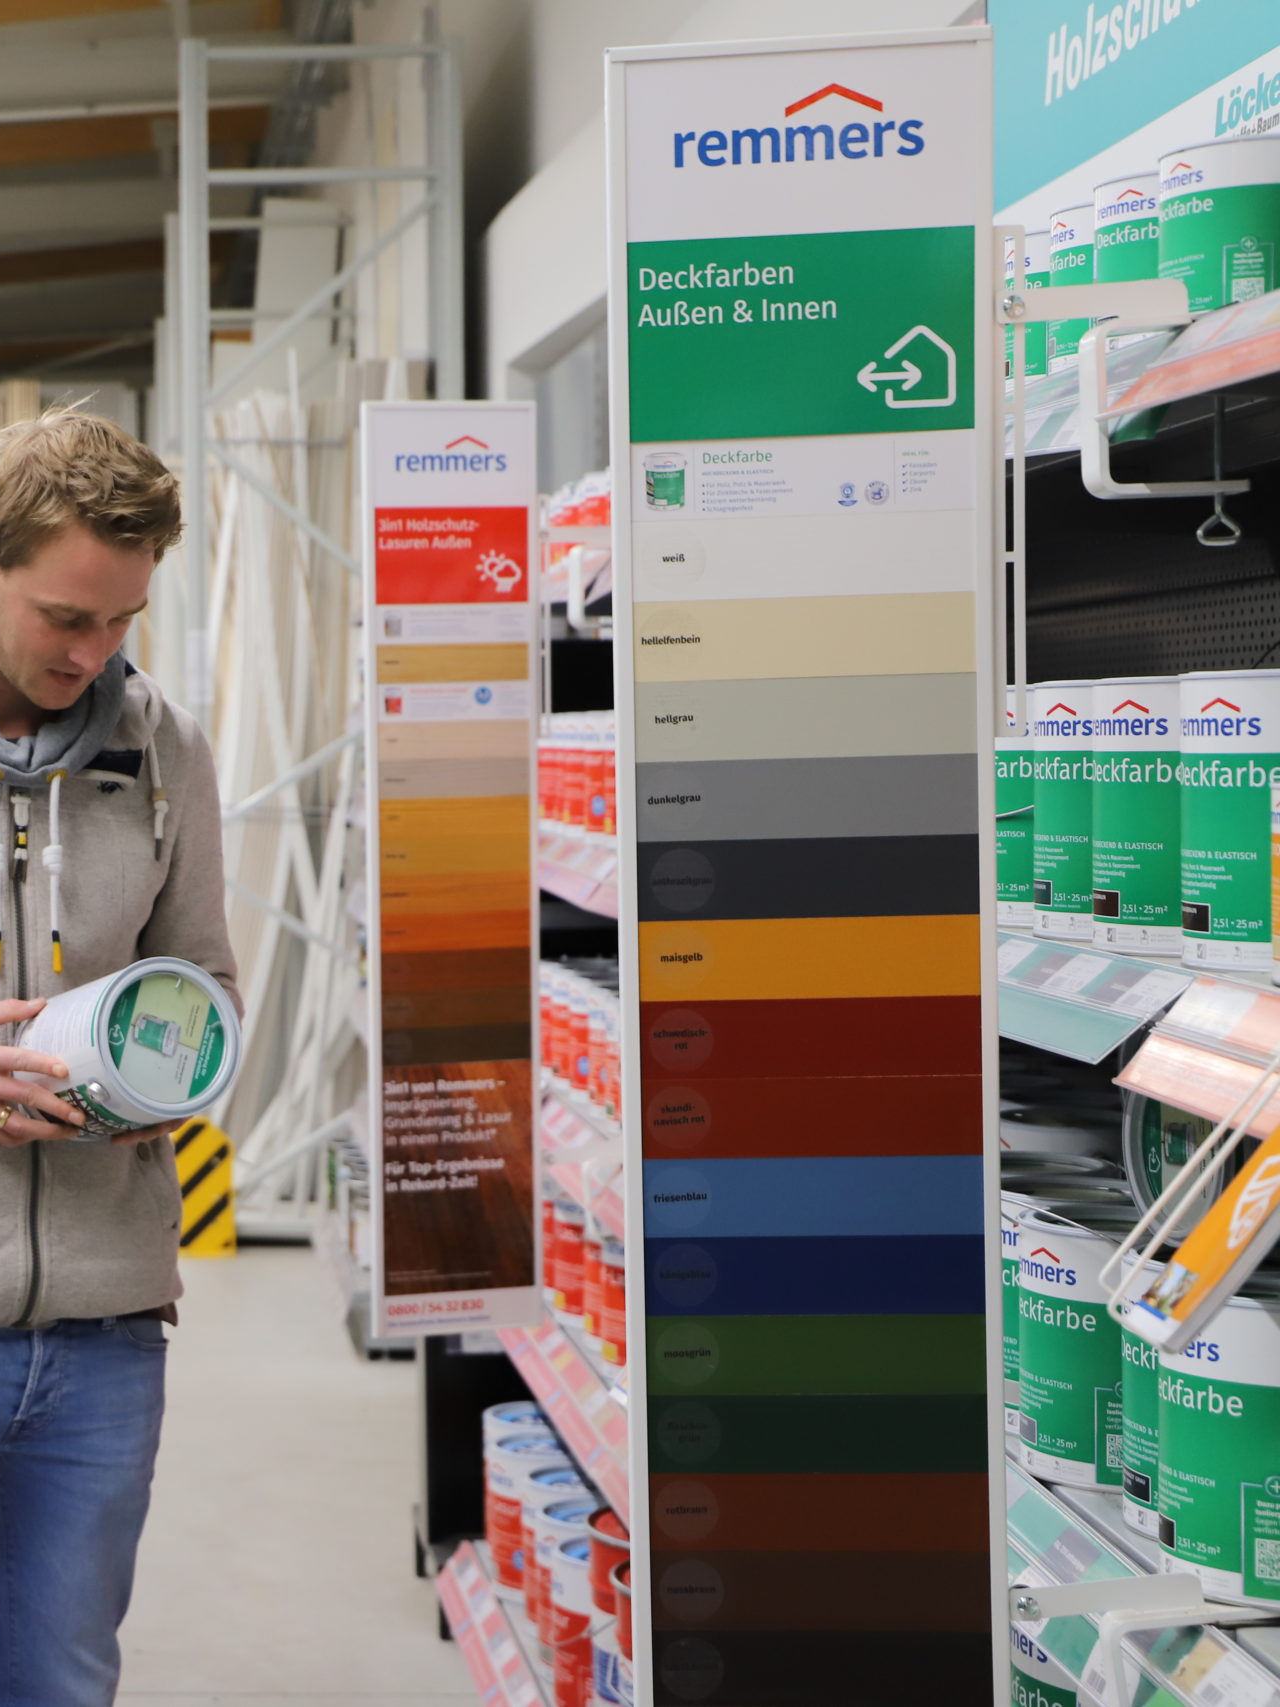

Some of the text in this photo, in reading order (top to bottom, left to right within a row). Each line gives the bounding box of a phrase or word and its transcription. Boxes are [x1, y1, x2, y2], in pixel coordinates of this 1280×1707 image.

[673, 119, 925, 168] remmers
[1097, 222, 1160, 249] Deckfarb
[638, 262, 794, 292] Deckfarben
[638, 297, 838, 328] Außen & Innen
[395, 452, 507, 472] remmers
[702, 450, 773, 465] Deckfarbe
[406, 517, 480, 531] Holzschutz-
[378, 534, 472, 550] Lasuren Außen
[662, 553, 685, 563] weiß
[641, 635, 701, 646] hellelfenbein
[654, 714, 694, 725] hellgrau
[1034, 719, 1093, 737] emmers
[1034, 756, 1093, 781] eckfarb
[647, 793, 701, 805] dunkelgrau
[996, 830, 1025, 838] LASTISCH
[660, 952, 703, 963] maisgelb
[653, 1192, 707, 1203] friesenblau
[1019, 1296, 1097, 1332] eckfarbe
[1158, 1375, 1244, 1417] eckfarbe
